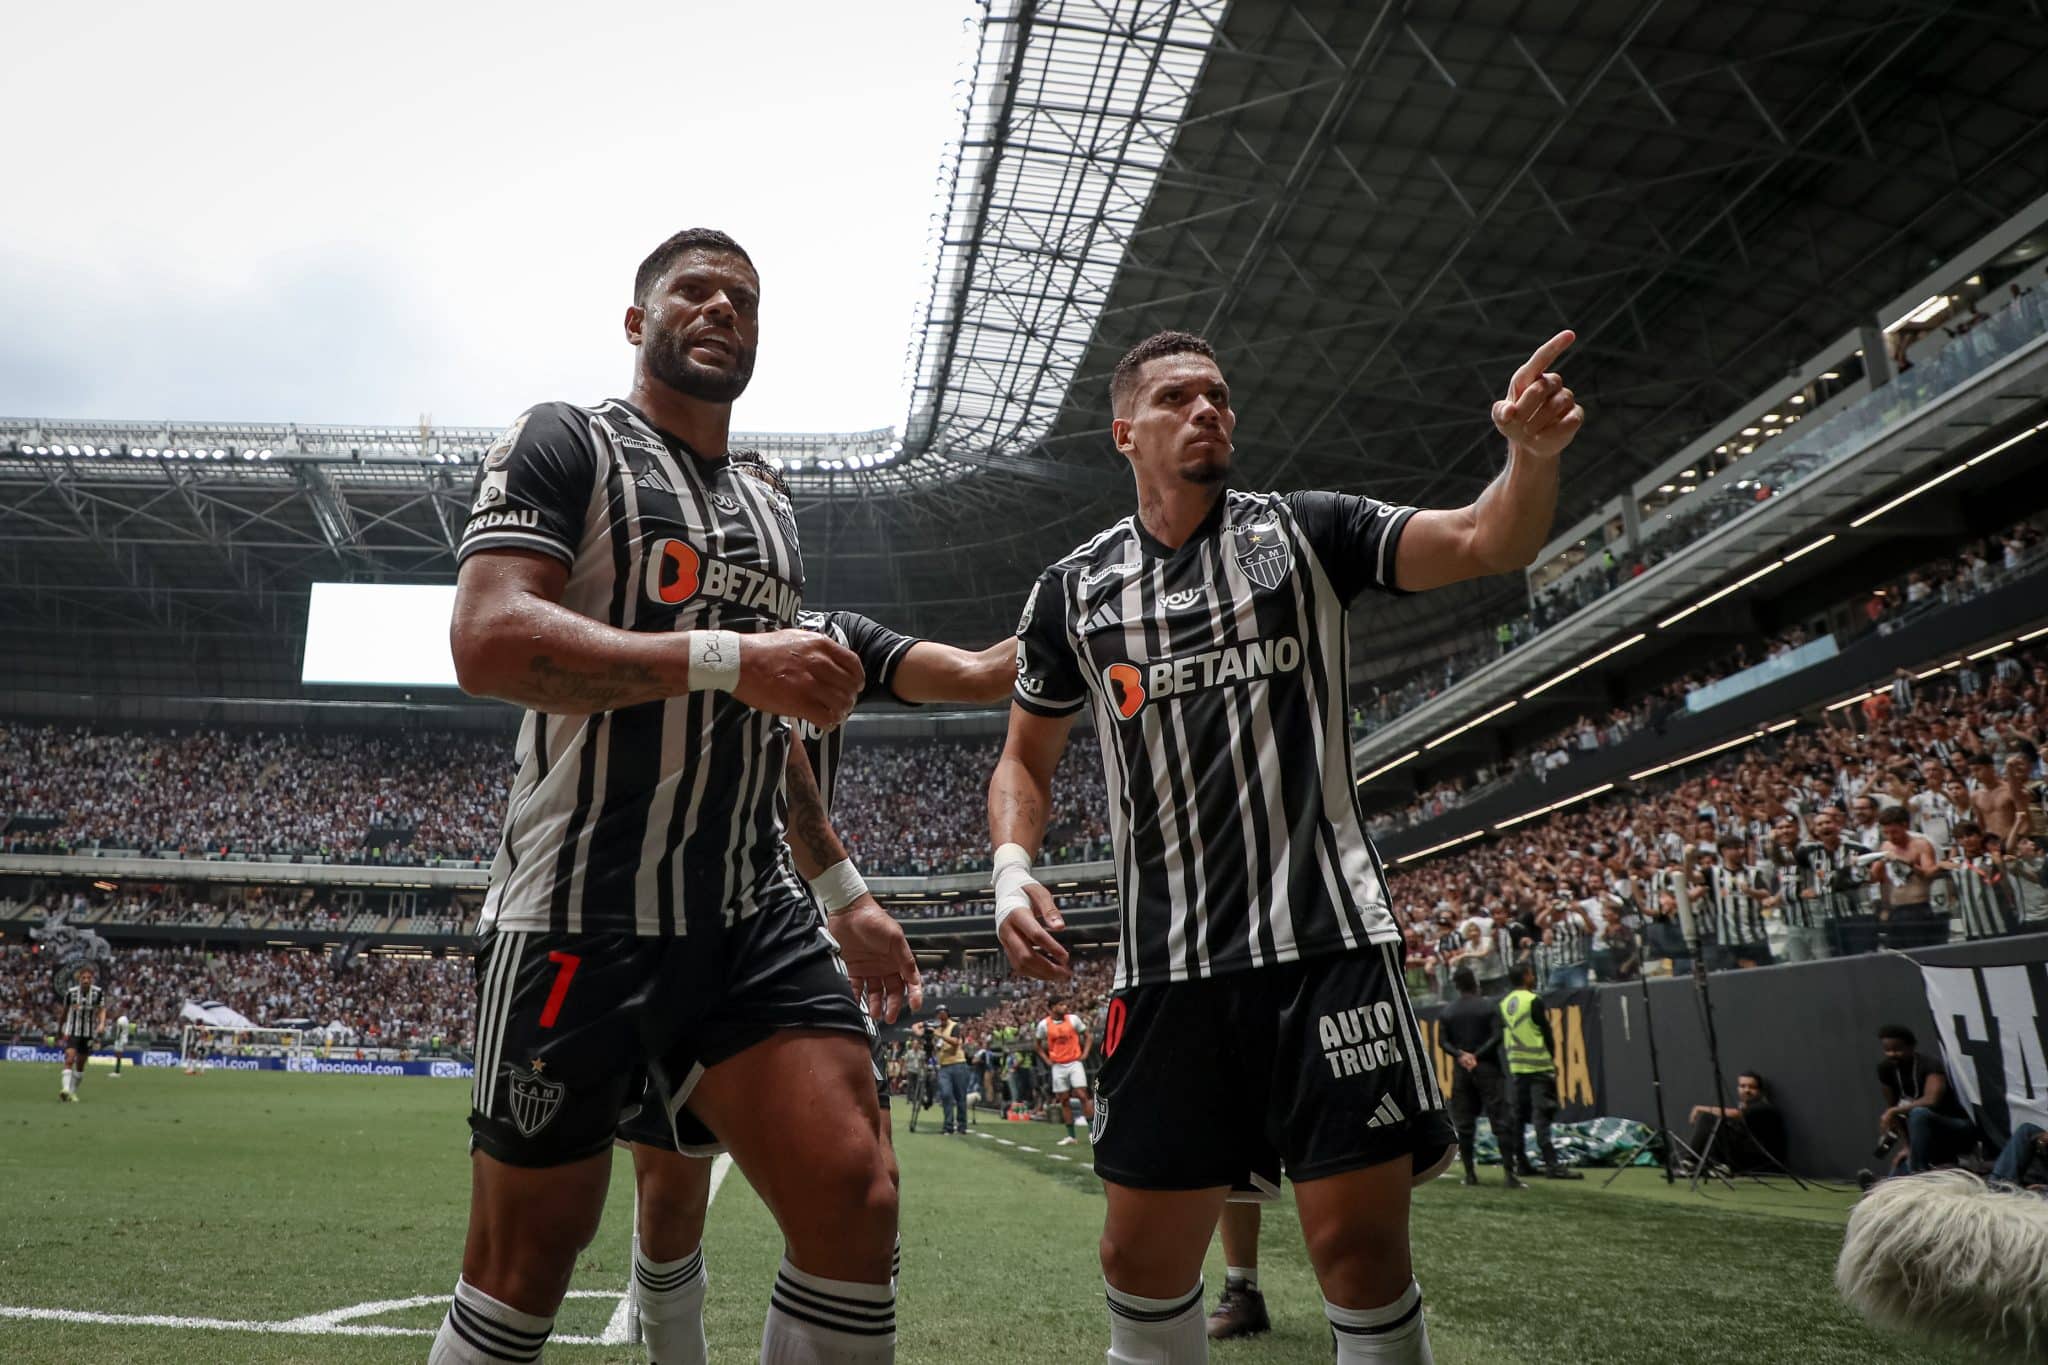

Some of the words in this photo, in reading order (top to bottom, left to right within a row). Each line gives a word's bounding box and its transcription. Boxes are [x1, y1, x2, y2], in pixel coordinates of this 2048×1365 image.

[462, 509, 539, 540] ERDAU
[1245, 548, 1279, 565] CAM
[1160, 589, 1195, 608] YOU
[1149, 637, 1299, 700] BETANO
[539, 951, 582, 1028] 7
[1319, 1001, 1394, 1050] AUTO
[1325, 1036, 1402, 1078] TRUCK
[518, 1083, 554, 1098] CAM
